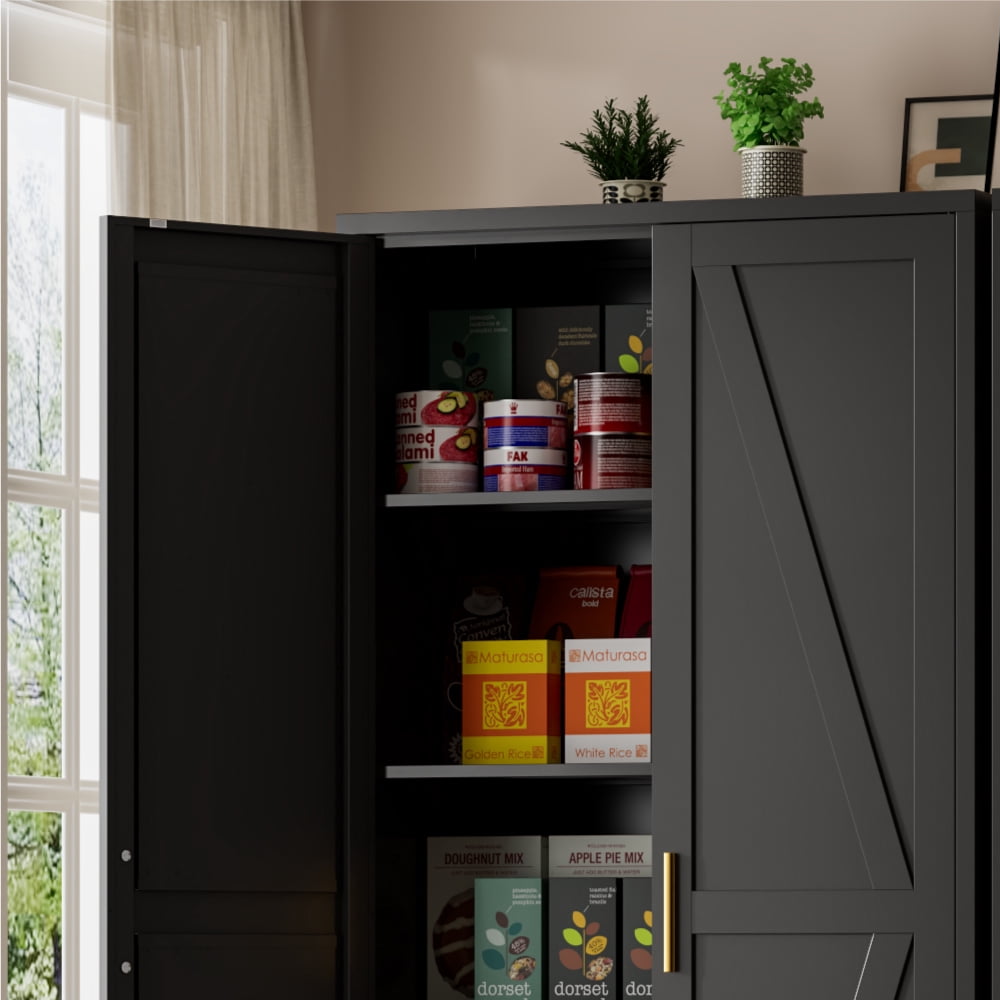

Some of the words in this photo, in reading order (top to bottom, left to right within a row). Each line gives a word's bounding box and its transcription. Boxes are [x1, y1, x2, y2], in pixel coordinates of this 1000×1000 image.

[556, 404, 568, 414] FA
[507, 451, 528, 462] FAK
[569, 586, 615, 598] calista
[581, 600, 600, 608] bold
[480, 651, 544, 664] Maturasa
[583, 649, 647, 662] Maturasa
[464, 749, 505, 760] Golden
[508, 748, 532, 759] Rice
[575, 747, 606, 758] White
[609, 747, 632, 758] Rice
[444, 852, 501, 865] DOUGHNUT
[504, 852, 524, 864] MIX
[569, 852, 602, 864] APPLE
[605, 852, 622, 864] PIE
[624, 852, 644, 864] MIX
[477, 981, 532, 996] dorset
[554, 981, 609, 996] dorset
